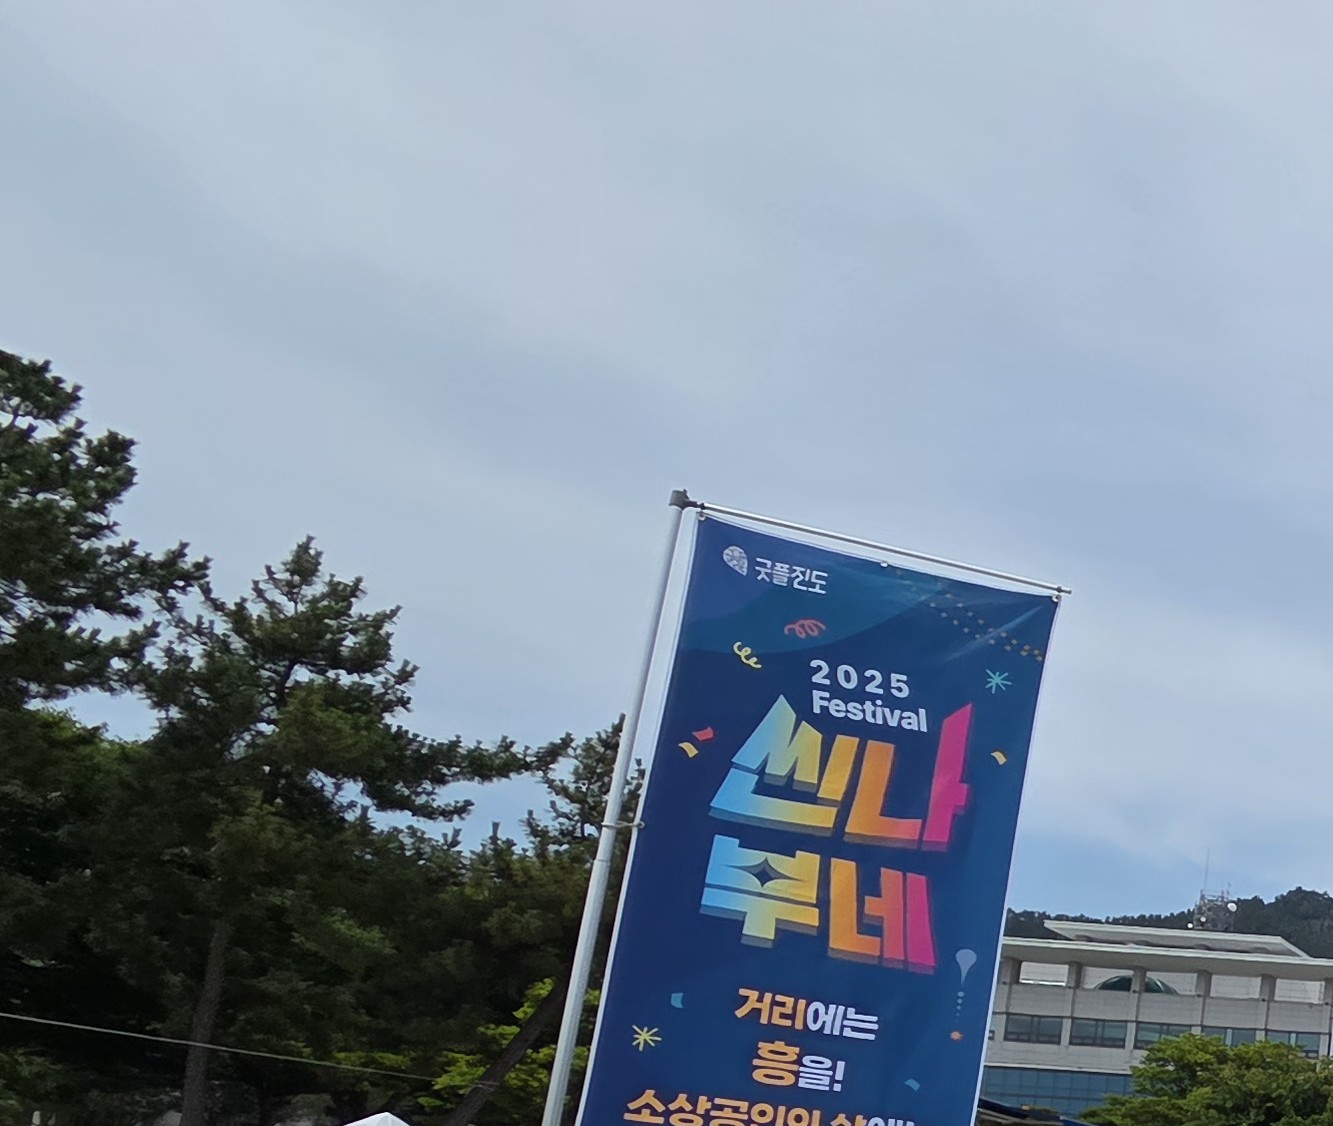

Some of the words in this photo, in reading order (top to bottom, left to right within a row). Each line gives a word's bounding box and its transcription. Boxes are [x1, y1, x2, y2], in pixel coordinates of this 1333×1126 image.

[809, 660, 910, 698] 2025
[811, 690, 928, 733] Festival
[734, 987, 880, 1042] 거리에는
[751, 1039, 846, 1092] 흥을!
